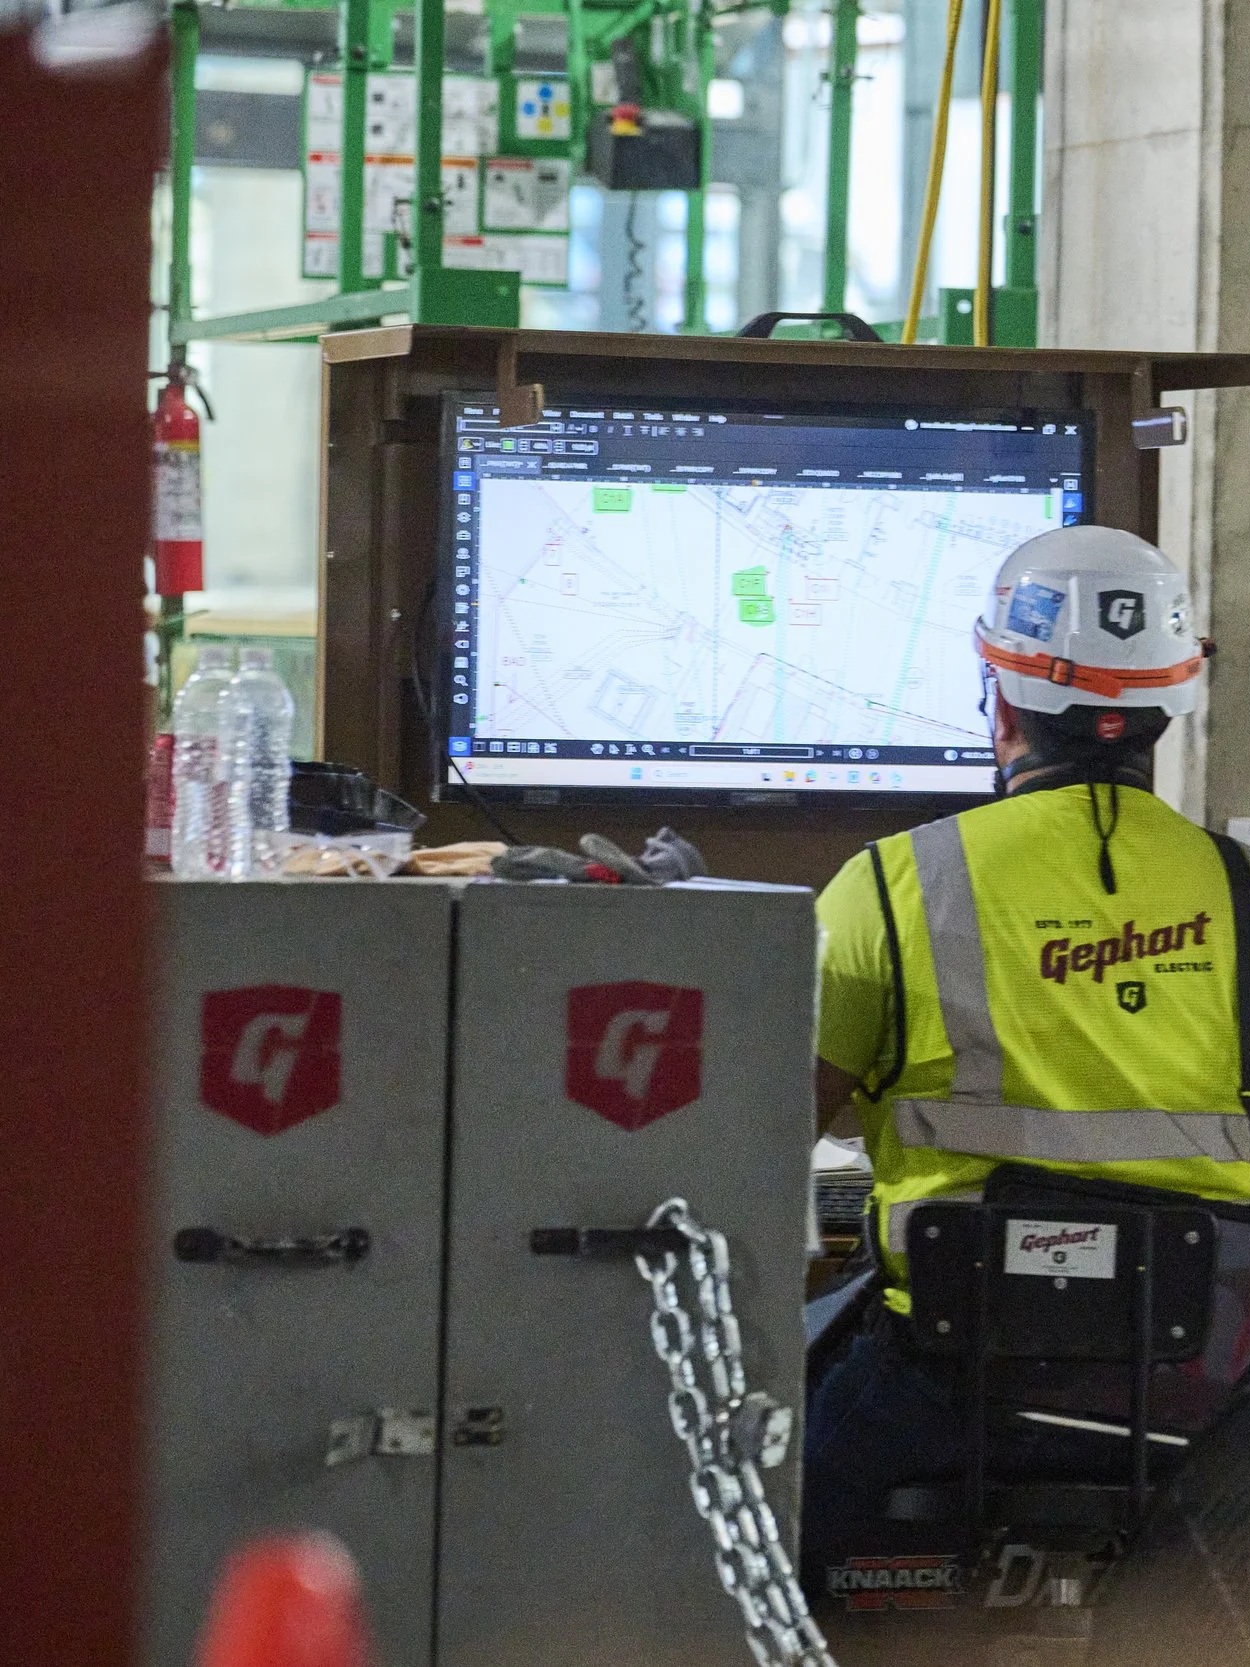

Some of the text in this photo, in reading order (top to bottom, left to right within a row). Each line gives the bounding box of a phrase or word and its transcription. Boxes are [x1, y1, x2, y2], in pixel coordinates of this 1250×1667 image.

[1039, 910, 1213, 985] Gephart
[1154, 961, 1214, 974] ELECTRIC
[1020, 1227, 1102, 1253] Gephart
[826, 1568, 959, 1590] KNAACK
